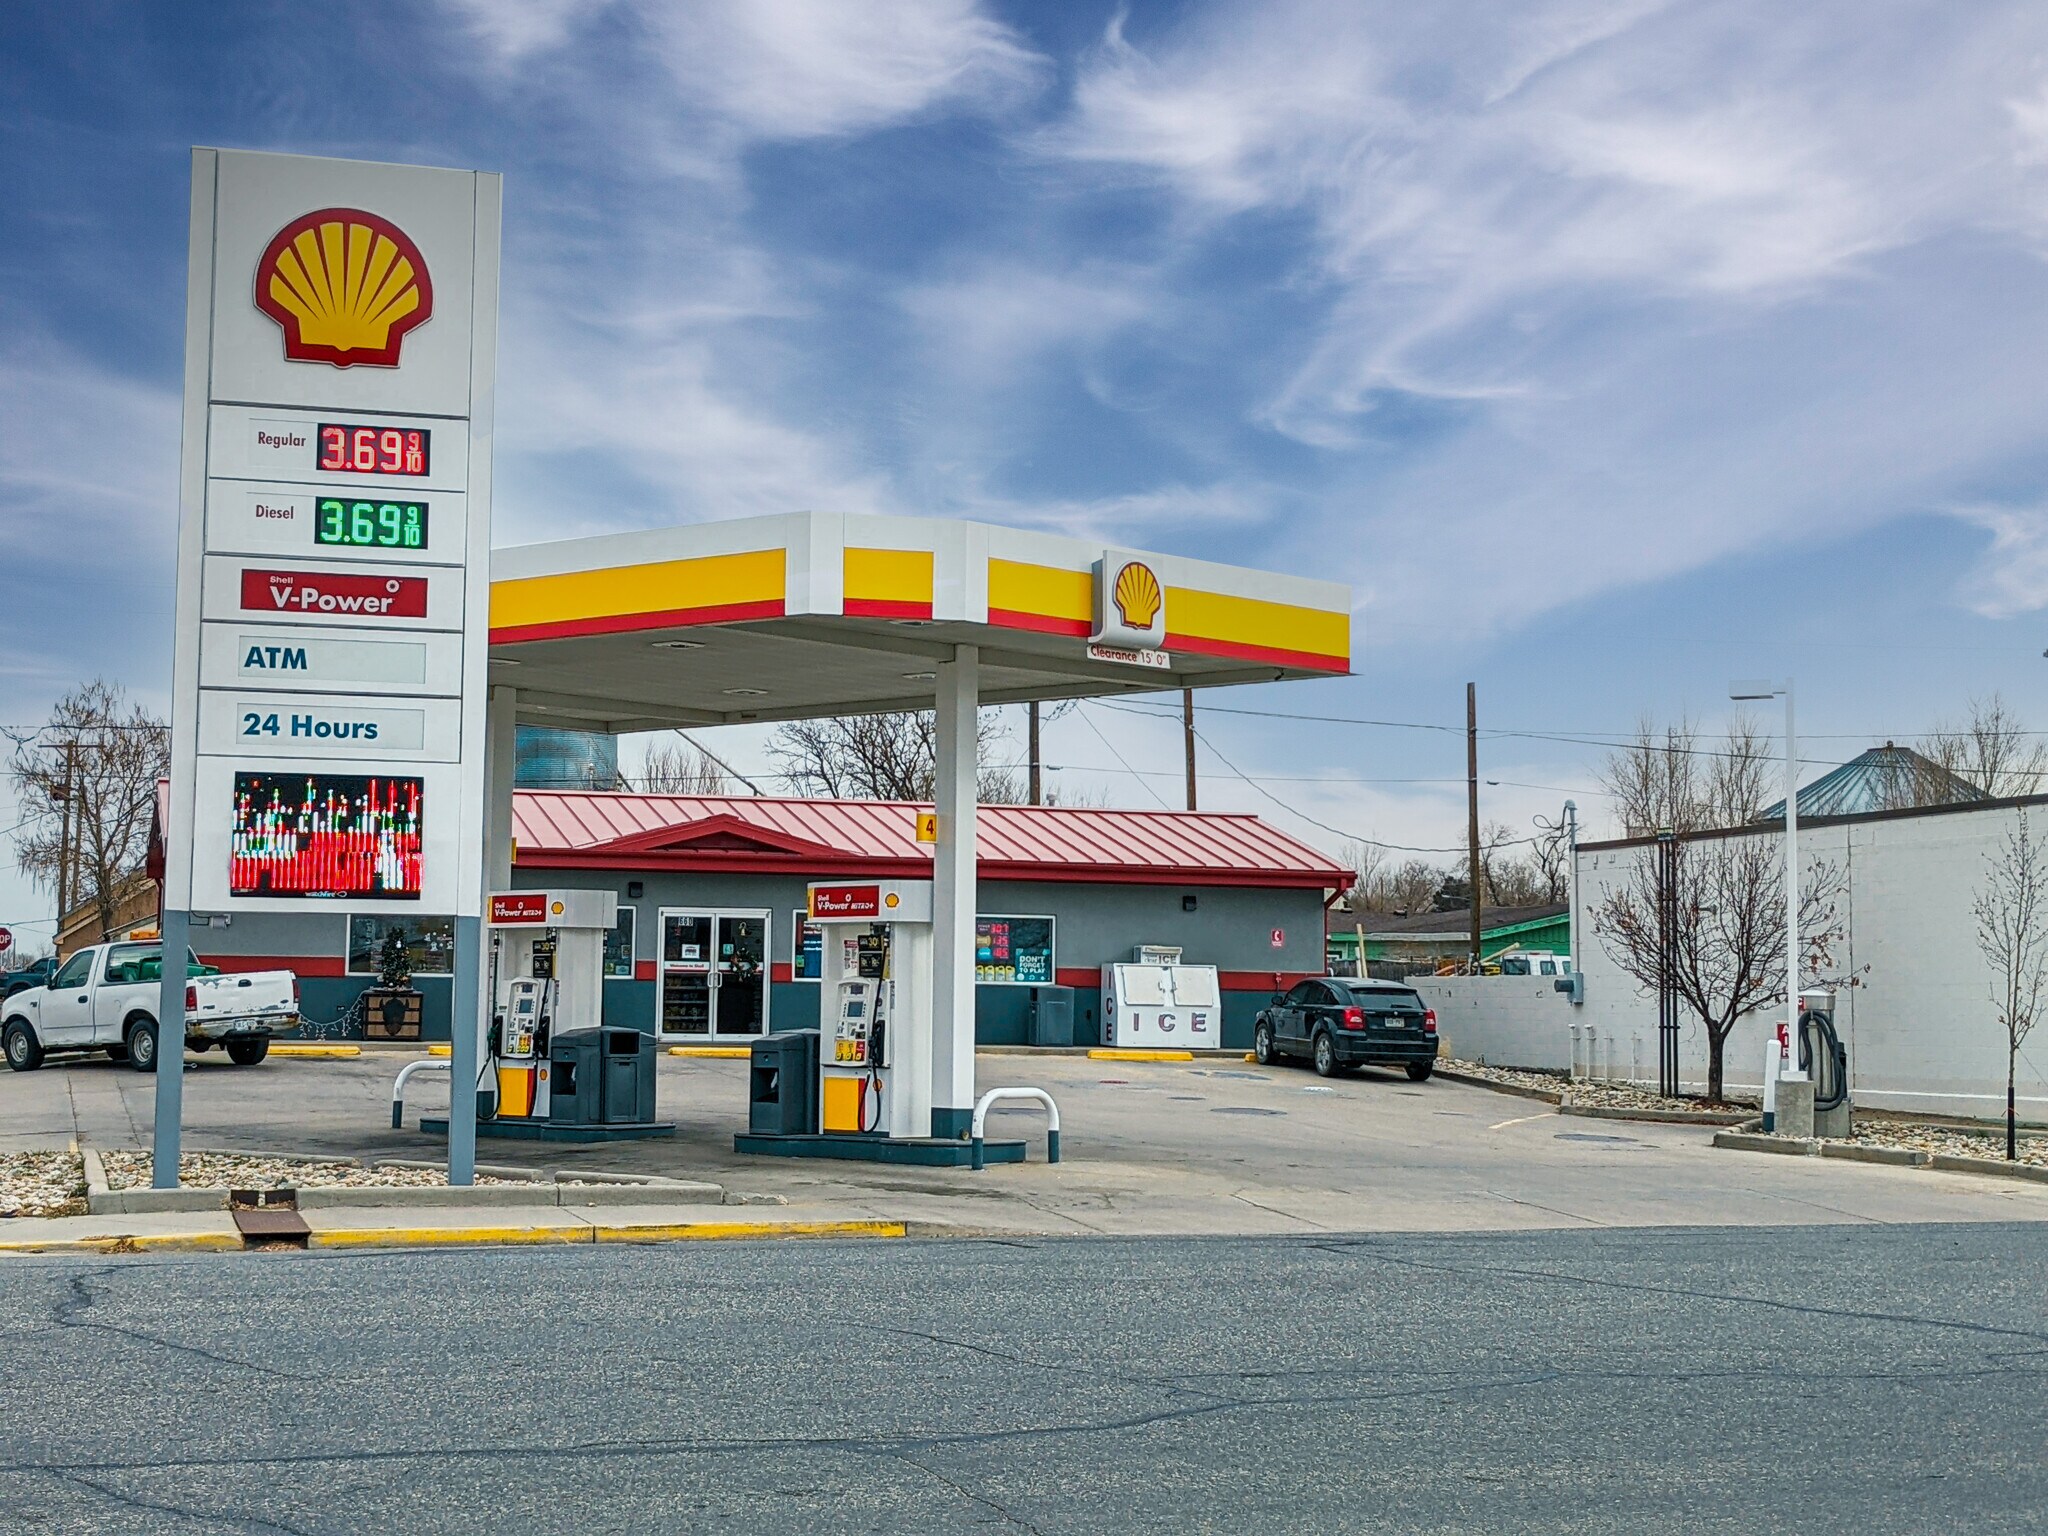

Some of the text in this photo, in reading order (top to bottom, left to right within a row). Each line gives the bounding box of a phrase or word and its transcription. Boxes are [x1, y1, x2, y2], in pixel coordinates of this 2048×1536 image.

[258, 431, 306, 448] Regular
[408, 432, 420, 451] 9
[322, 428, 402, 471] 3.69
[406, 453, 421, 472] 10
[255, 504, 294, 519] Diesel
[407, 506, 418, 525] 9
[321, 501, 400, 544] 3.69
[404, 527, 420, 545] 10
[269, 575, 294, 585] Shell
[269, 585, 395, 613] V-Power
[243, 646, 308, 670] ATM
[1090, 645, 1137, 663] Clearance
[242, 712, 378, 740] 24 Hours
[926, 819, 934, 834] 4
[817, 901, 850, 910] V-Power
[0, 934, 10, 944] OP
[1019, 955, 1046, 963] DON'T
[1159, 954, 1178, 964] ICE
[1105, 971, 1113, 1042] ICE
[1133, 1012, 1207, 1032] ICE
